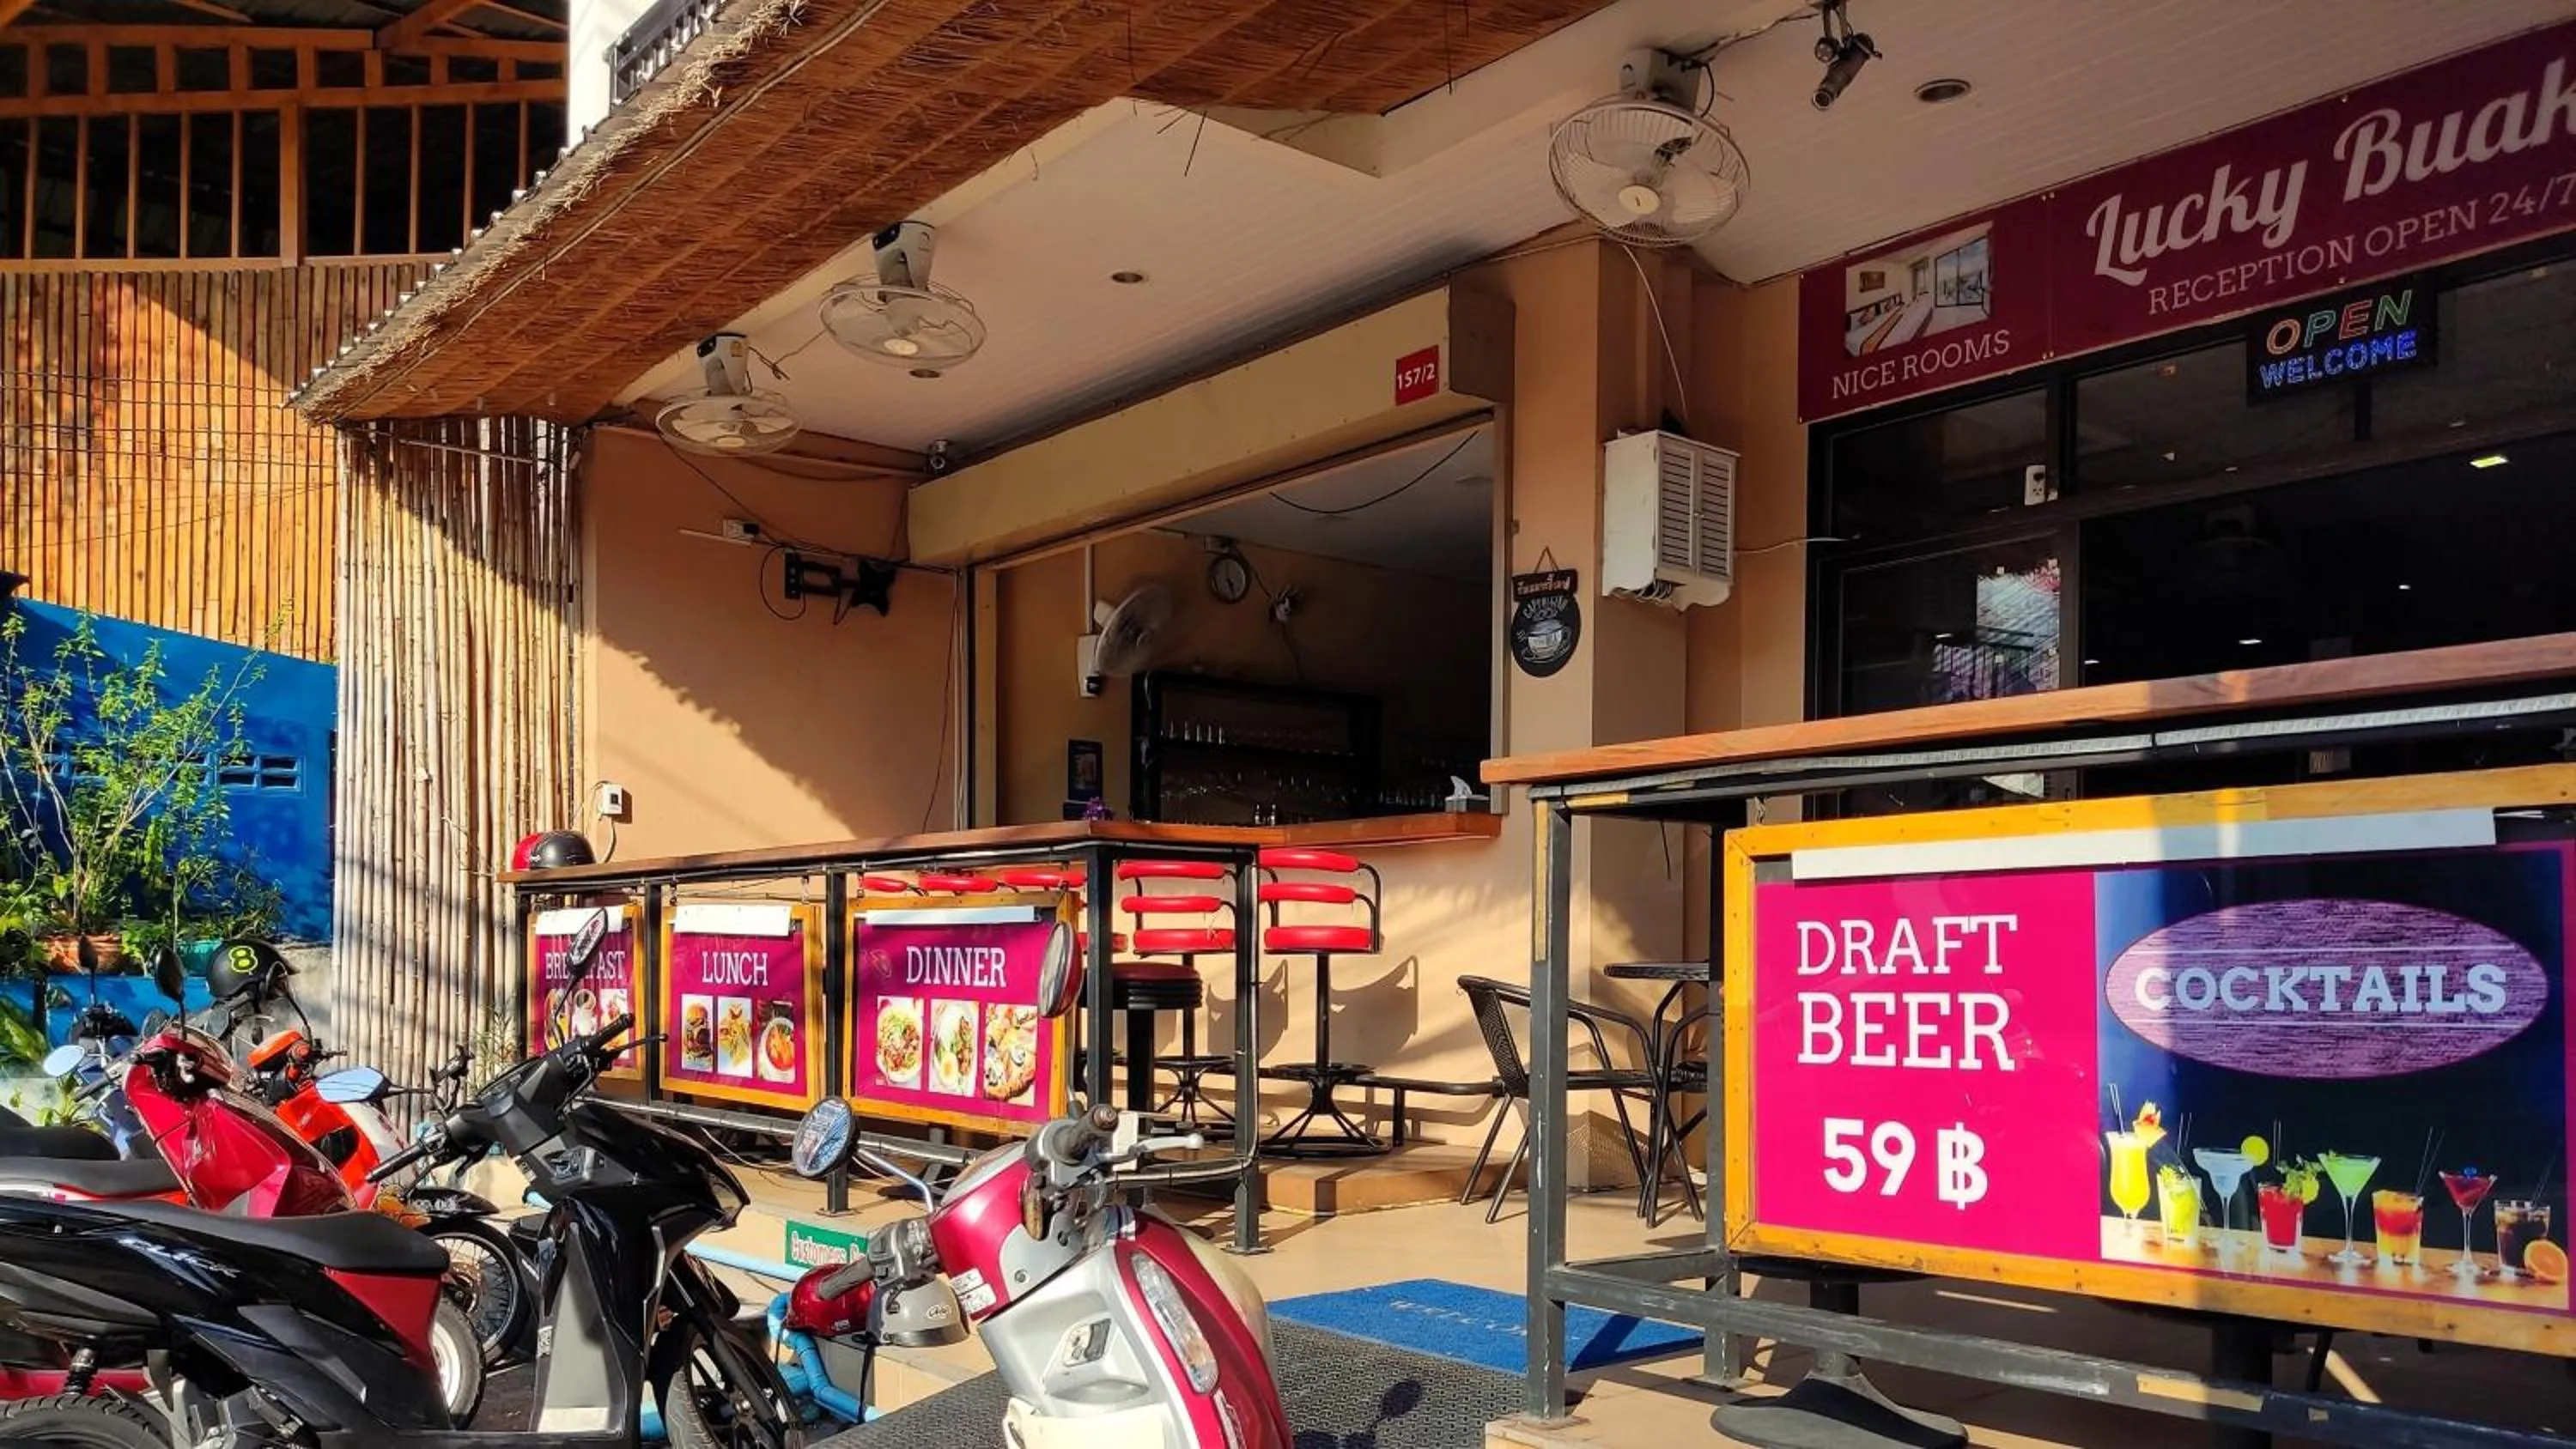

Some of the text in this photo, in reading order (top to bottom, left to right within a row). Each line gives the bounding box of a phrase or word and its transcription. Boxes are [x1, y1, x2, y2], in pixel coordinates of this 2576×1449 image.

[2087, 160, 2308, 287] Lucky
[2148, 173, 2576, 316] RECEPTION OPEN 24/7
[2266, 289, 2413, 355] OPEN
[1397, 362, 1436, 389] 157/2
[1832, 329, 2010, 399] NICE ROOMS
[2258, 330, 2417, 389] WELCOME
[701, 951, 769, 987] LUNCH
[905, 945, 1007, 988] DINNER
[1797, 914, 2018, 976] DRAFT
[2135, 964, 2508, 1014] COCKTAILS
[1797, 991, 2015, 1071] BEER
[1823, 1118, 1916, 1195] 59
